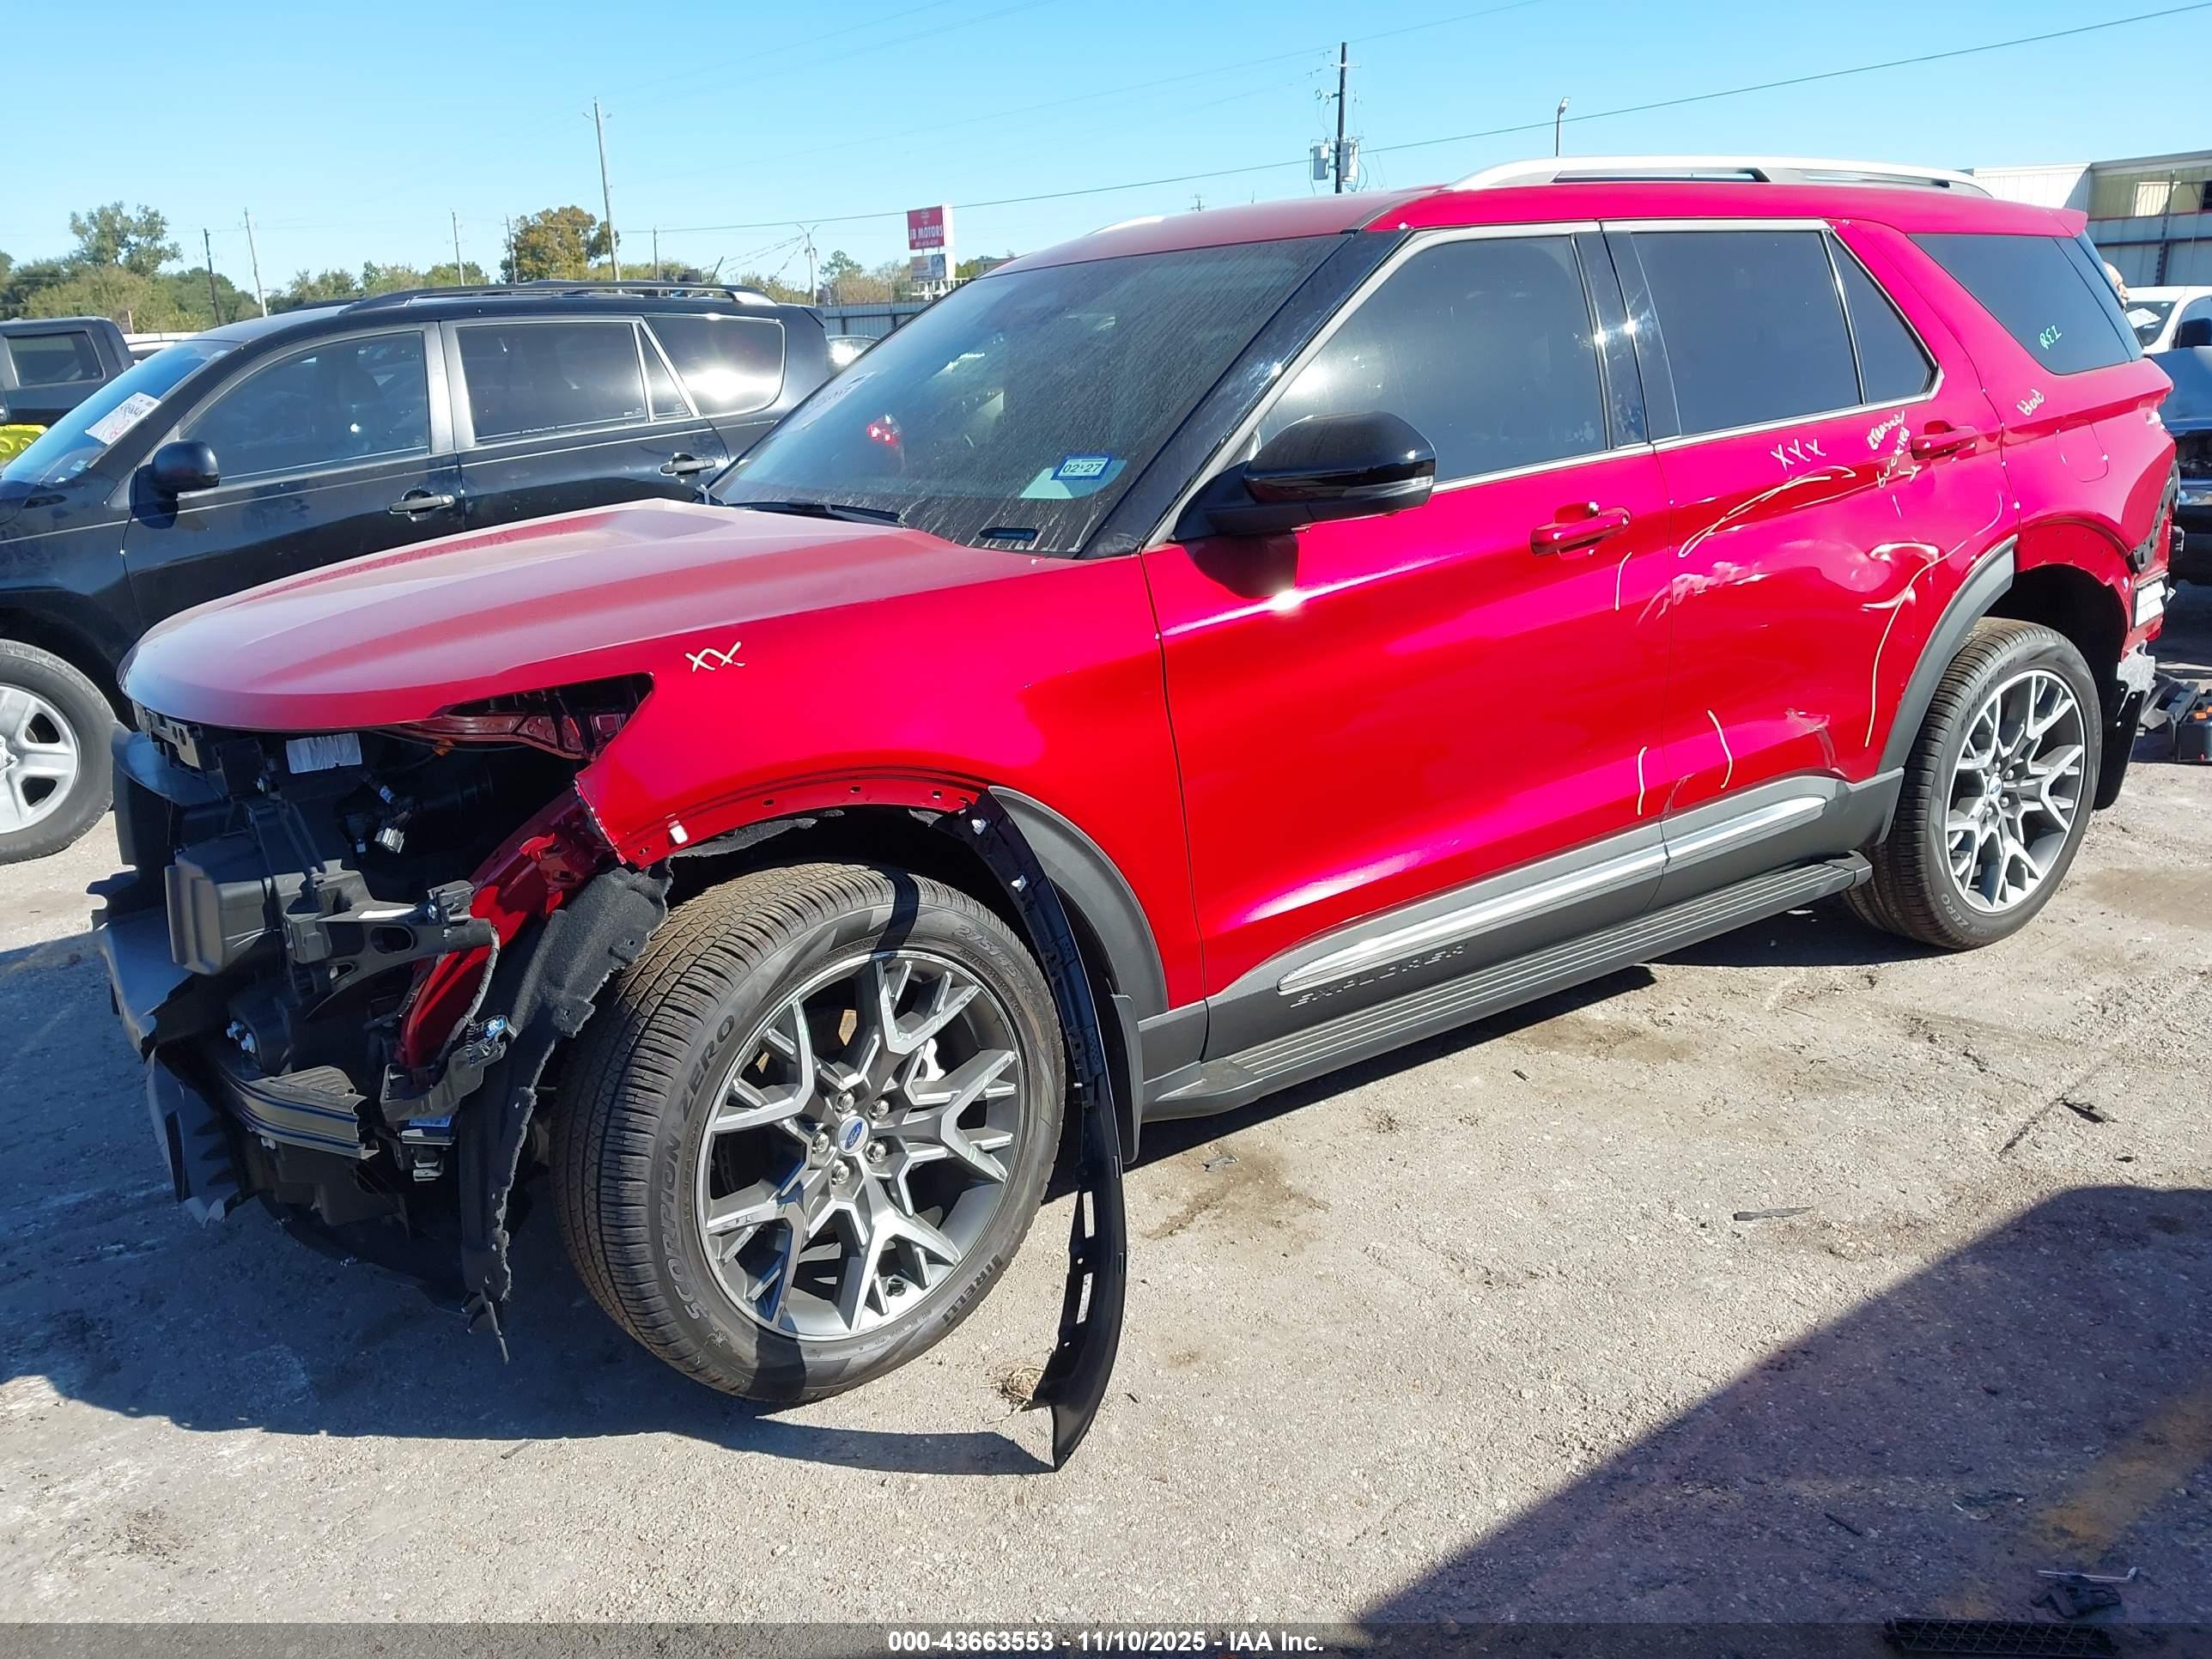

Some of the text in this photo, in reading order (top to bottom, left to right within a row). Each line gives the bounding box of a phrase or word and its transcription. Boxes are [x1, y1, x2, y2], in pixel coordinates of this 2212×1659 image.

[917, 224, 944, 240] MOTORS
[684, 641, 746, 673] XX
[1941, 893, 1970, 928] ZERO
[659, 1014, 735, 1320] SCORPION ZERO
[941, 1254, 1003, 1322] PIRELLI
